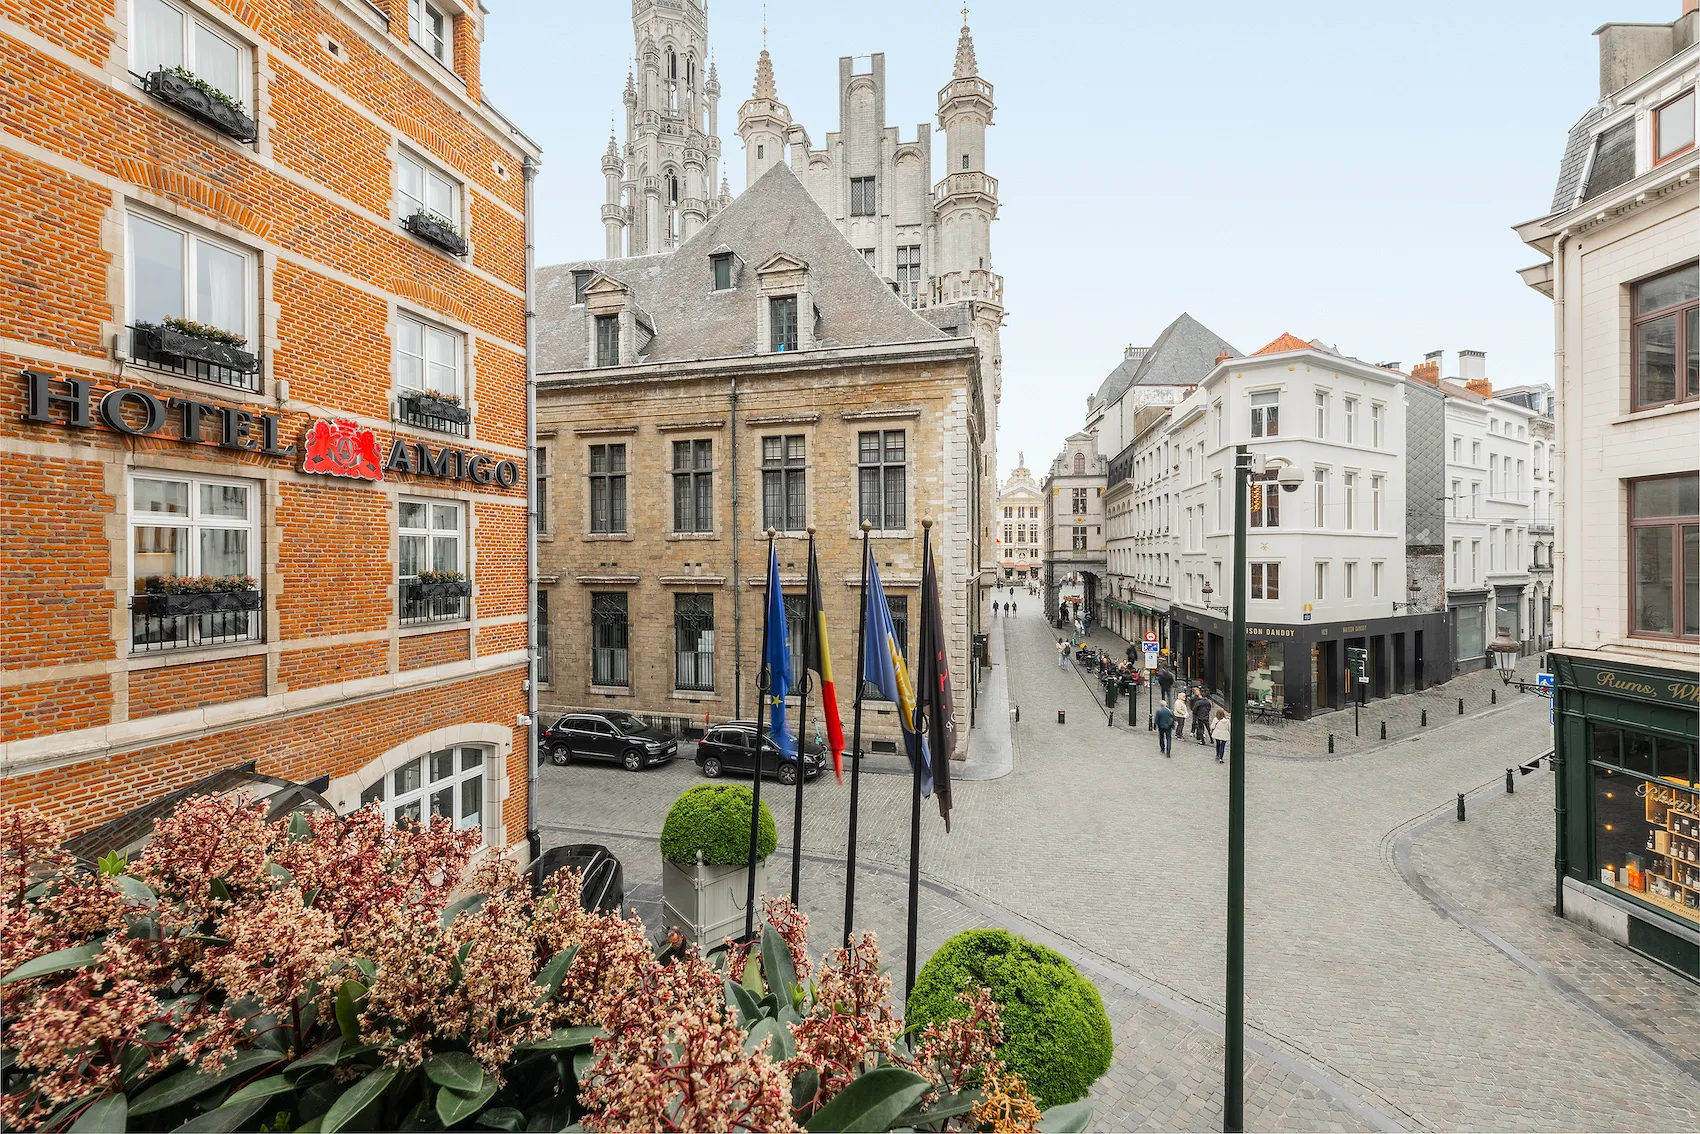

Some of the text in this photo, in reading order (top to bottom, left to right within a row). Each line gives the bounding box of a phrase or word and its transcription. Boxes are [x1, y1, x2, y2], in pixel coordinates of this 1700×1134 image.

[20, 369, 520, 488] HOTEL AMIGO
[1246, 627, 1295, 636] ISON DANDOY
[1596, 671, 1657, 697] Rums,
